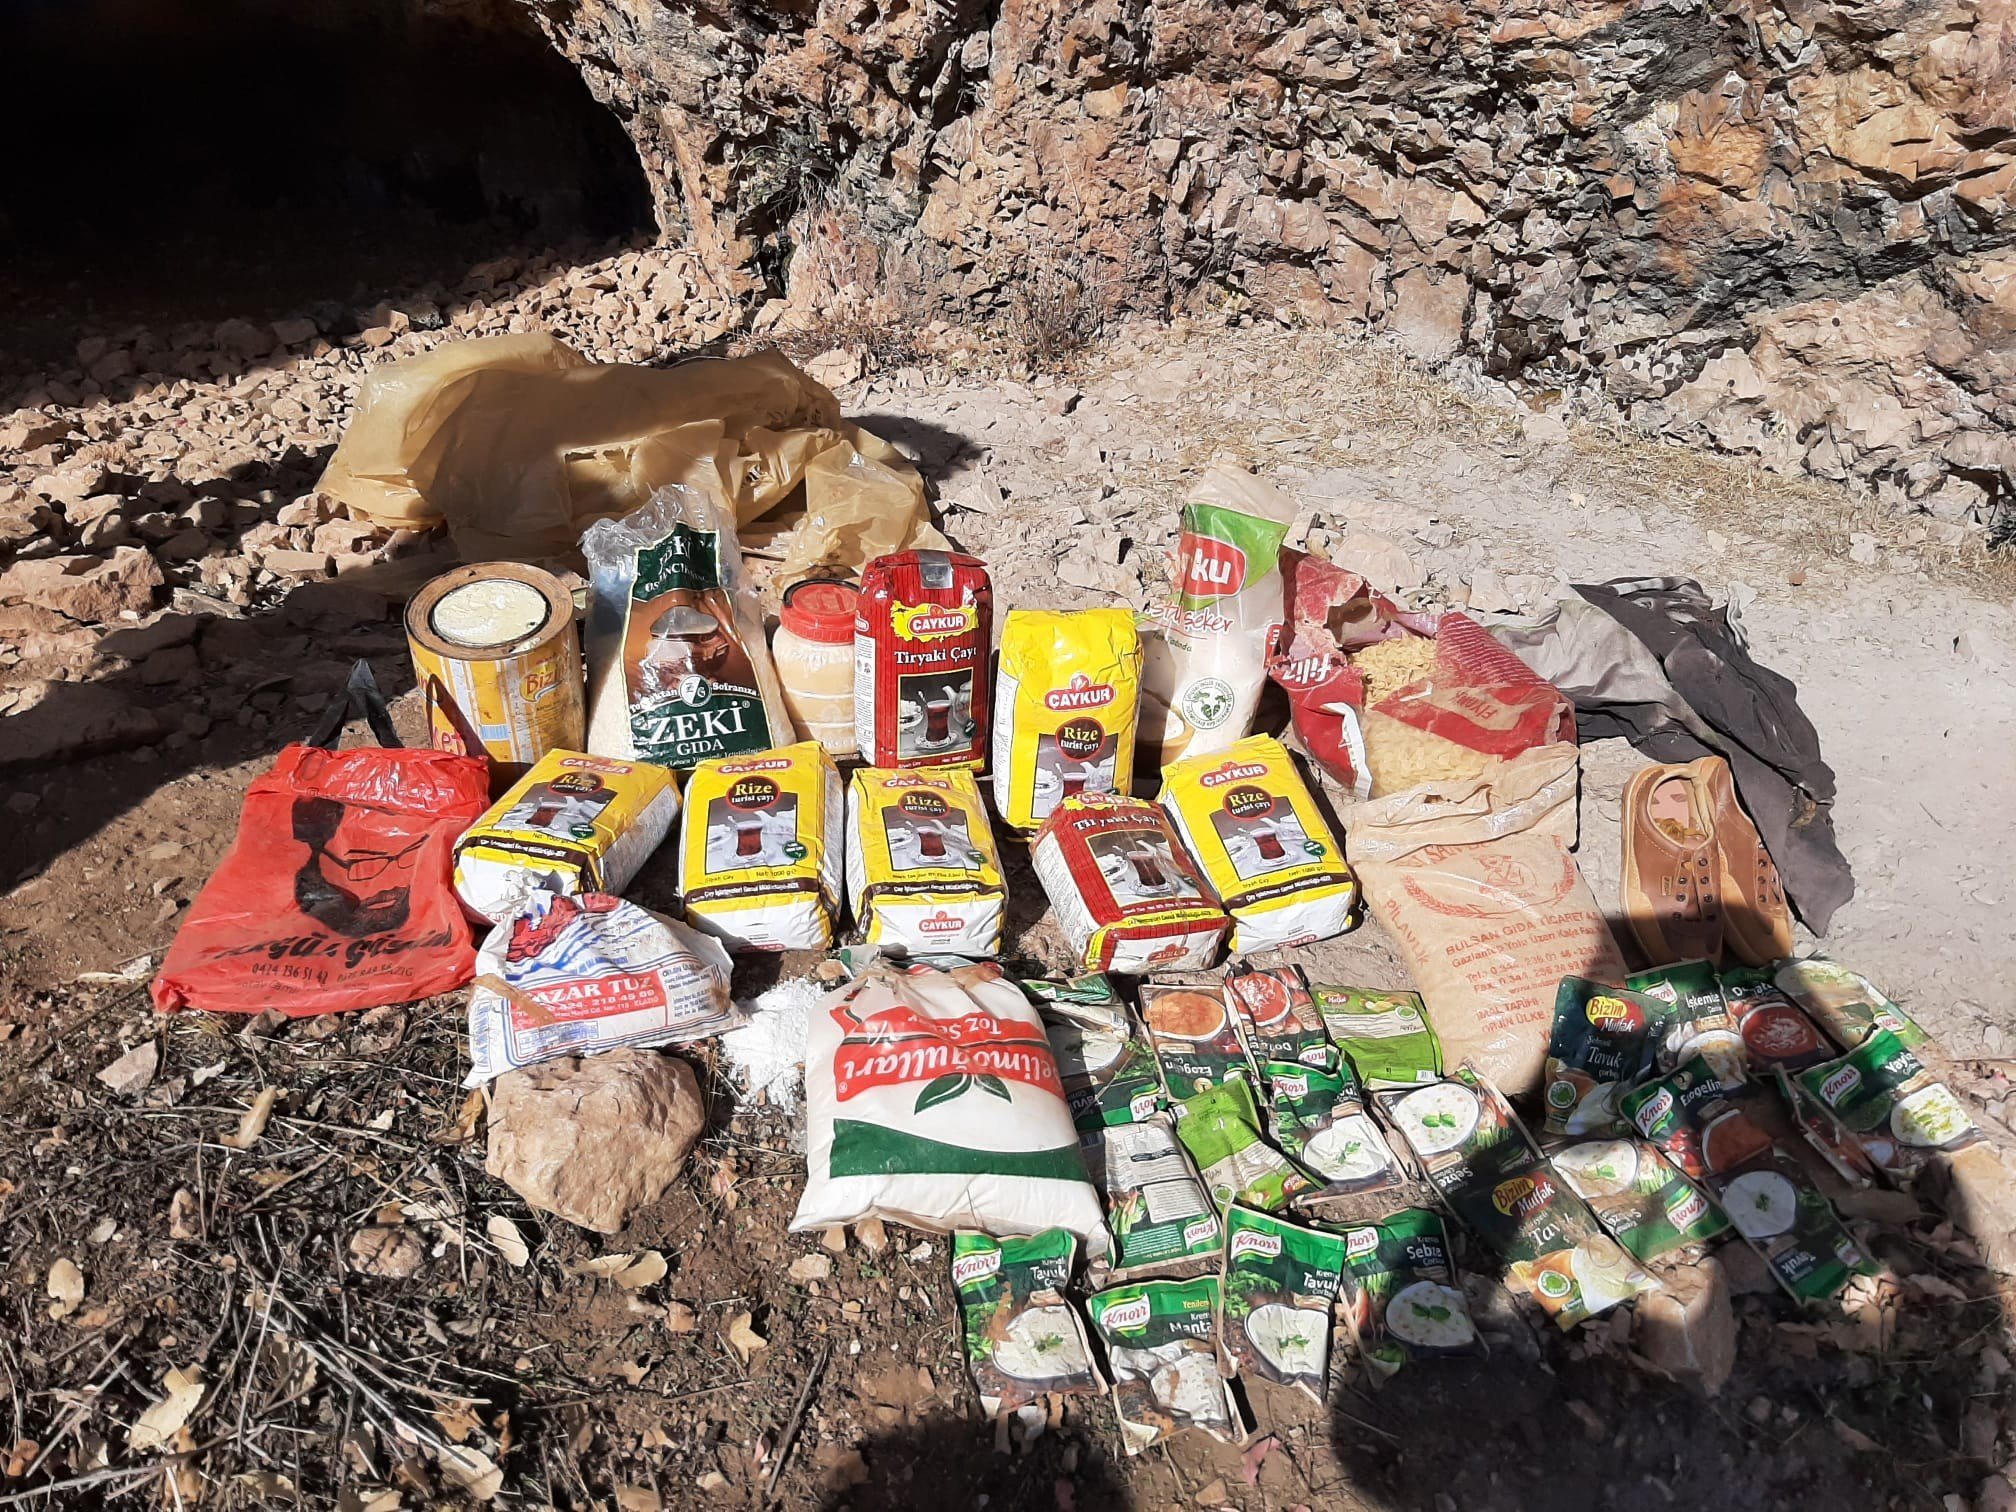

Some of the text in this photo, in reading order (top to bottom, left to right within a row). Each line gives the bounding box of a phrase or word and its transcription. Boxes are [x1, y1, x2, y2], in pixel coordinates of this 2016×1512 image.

[895, 645, 977, 667] Tiryaki Çayı
[712, 682, 758, 697] Sofranıza
[1048, 687, 1111, 710] ÇAYKUR
[648, 700, 748, 746] ZEKİ
[1063, 725, 1099, 741] Rize
[676, 738, 724, 756] GIDA
[1060, 739, 1083, 750] turist
[1203, 765, 1266, 786] ÇAYKUR
[731, 793, 756, 804] turist
[735, 782, 773, 796] Rize
[1228, 791, 1265, 807] Rize
[905, 794, 943, 807] Rize
[1502, 921, 1536, 936] GIDA
[527, 975, 655, 1006] AZAR TUZ
[1588, 998, 1625, 1018] Bizim
[964, 1016, 1002, 1037] Toz
[1600, 1017, 1636, 1033] Mutfak
[1588, 1046, 1623, 1067] Tavuk
[1822, 1068, 1857, 1098] Knorr
[1638, 1093, 1672, 1126] Knorr
[1437, 1166, 1474, 1188] Sebze
[1495, 1177, 1535, 1208] Bizim
[1516, 1181, 1556, 1217] Mutfak
[1186, 1222, 1215, 1241] Knorr
[1347, 1231, 1376, 1249] norr
[1234, 1233, 1281, 1252] Knorr
[955, 1254, 999, 1278] Knorr
[1029, 1265, 1068, 1282] Tavuk
[1101, 1303, 1150, 1327] Knorr
